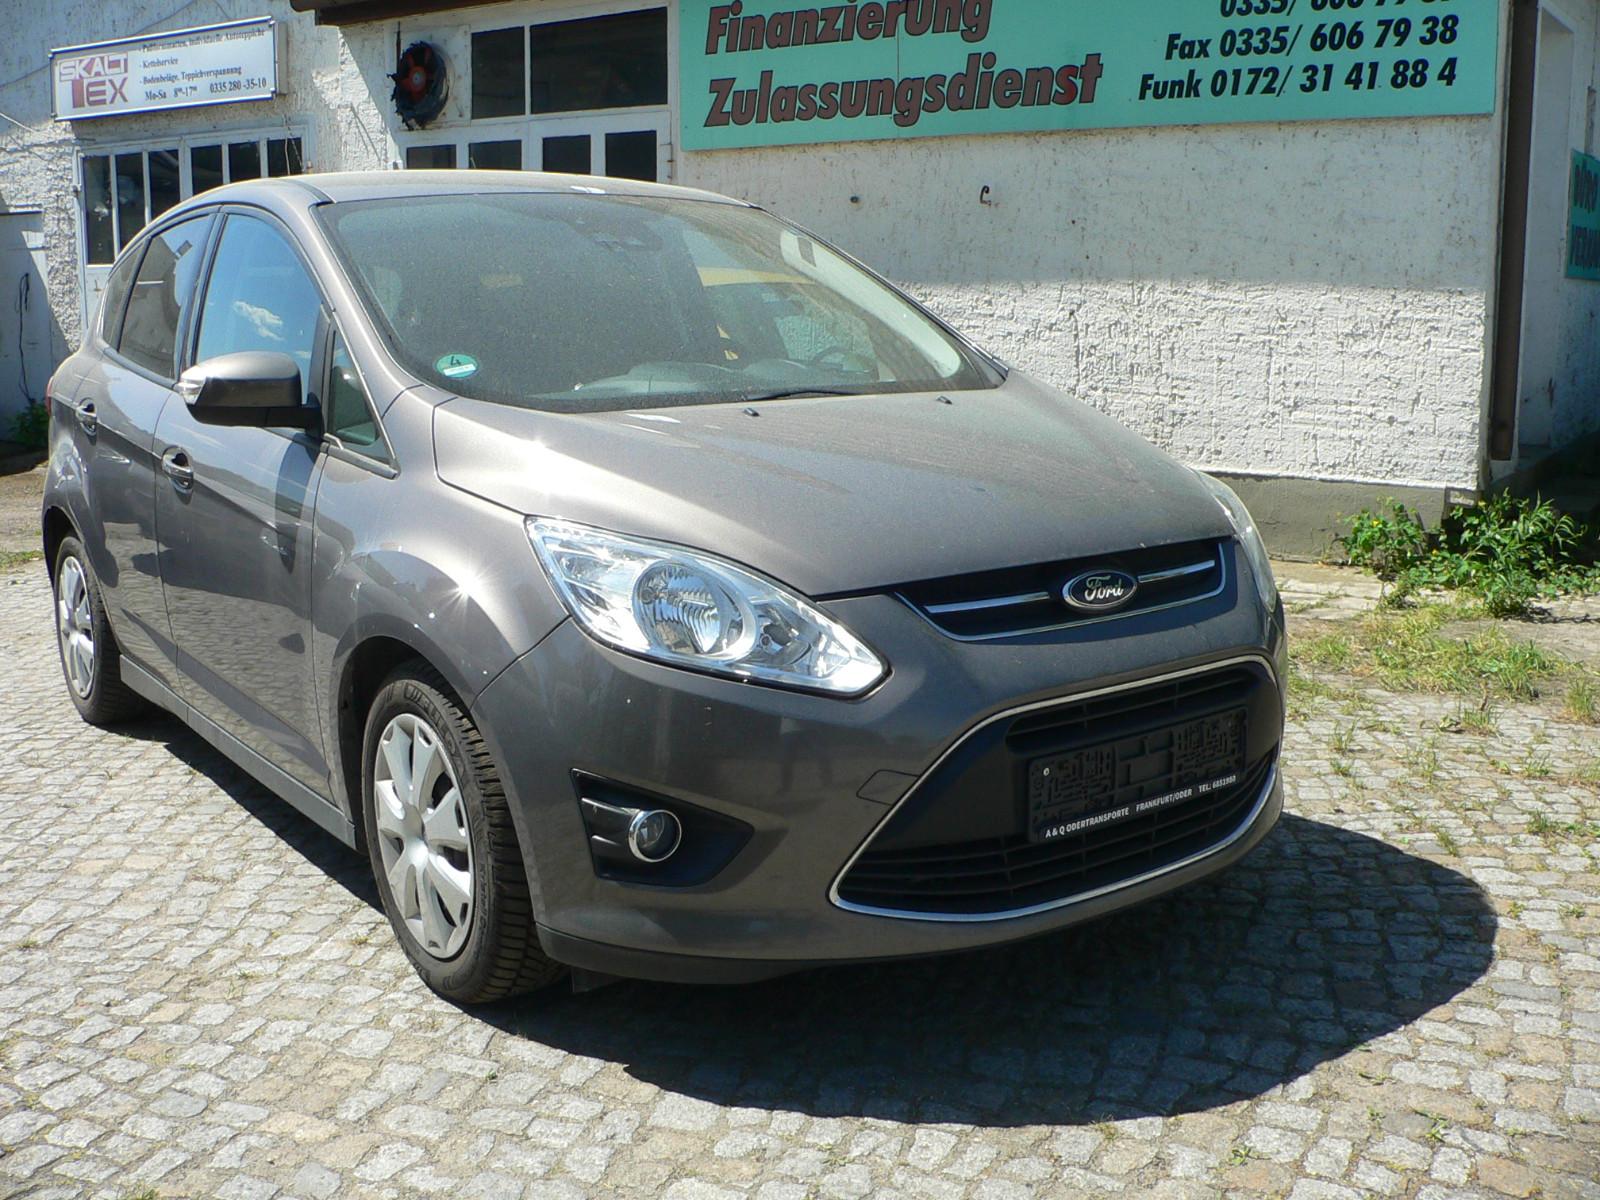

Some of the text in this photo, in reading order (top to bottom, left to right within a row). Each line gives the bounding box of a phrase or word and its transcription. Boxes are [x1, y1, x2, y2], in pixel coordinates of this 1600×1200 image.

[1165, 14, 1459, 61] Fax 0335/ 606 79 38
[210, 80, 227, 94] 0335
[704, 51, 1104, 128] Zulassungsdienst
[1138, 56, 1458, 100] Funk 0172/ 31 41 88 4
[1084, 575, 1124, 602] Ford
[1045, 828, 1052, 838] A
[1065, 806, 1130, 832] ODERTRANSPORTE
[1135, 787, 1193, 812] FRANKFURT/ODER
